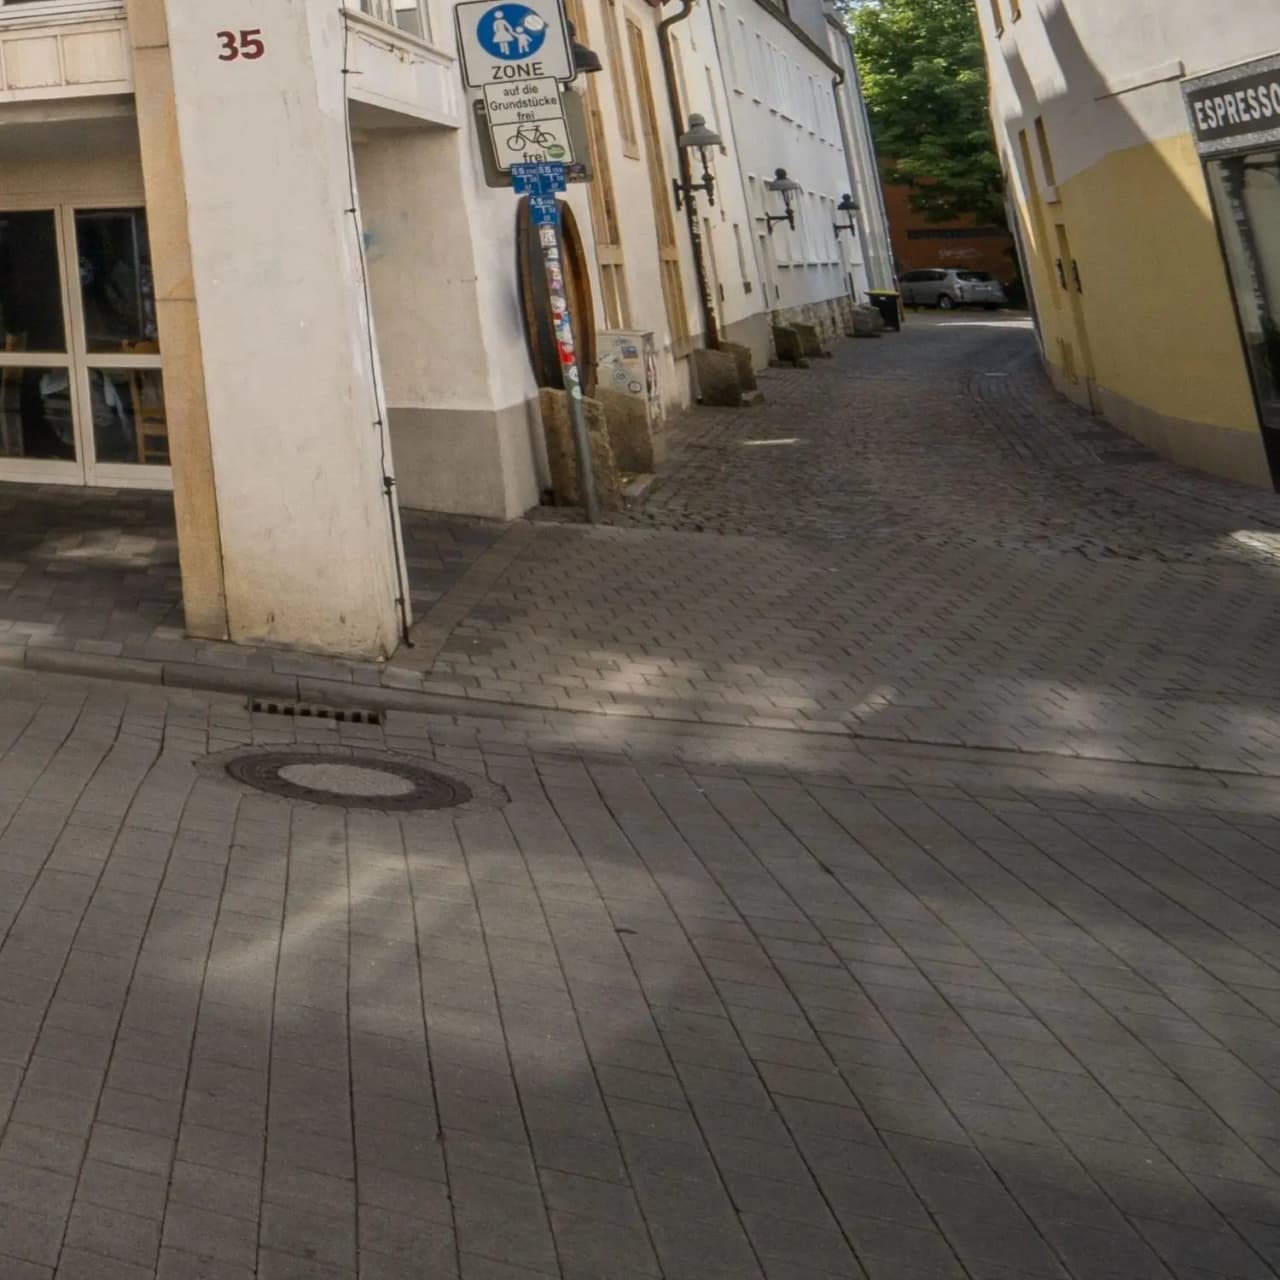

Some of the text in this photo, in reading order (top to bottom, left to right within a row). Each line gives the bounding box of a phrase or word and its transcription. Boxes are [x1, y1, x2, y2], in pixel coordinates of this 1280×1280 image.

[216, 29, 265, 61] 35
[492, 62, 545, 80] ZONE
[503, 84, 539, 97] auf die
[490, 96, 558, 111] Grundstücke
[517, 111, 536, 121] frei
[523, 151, 547, 163] frei
